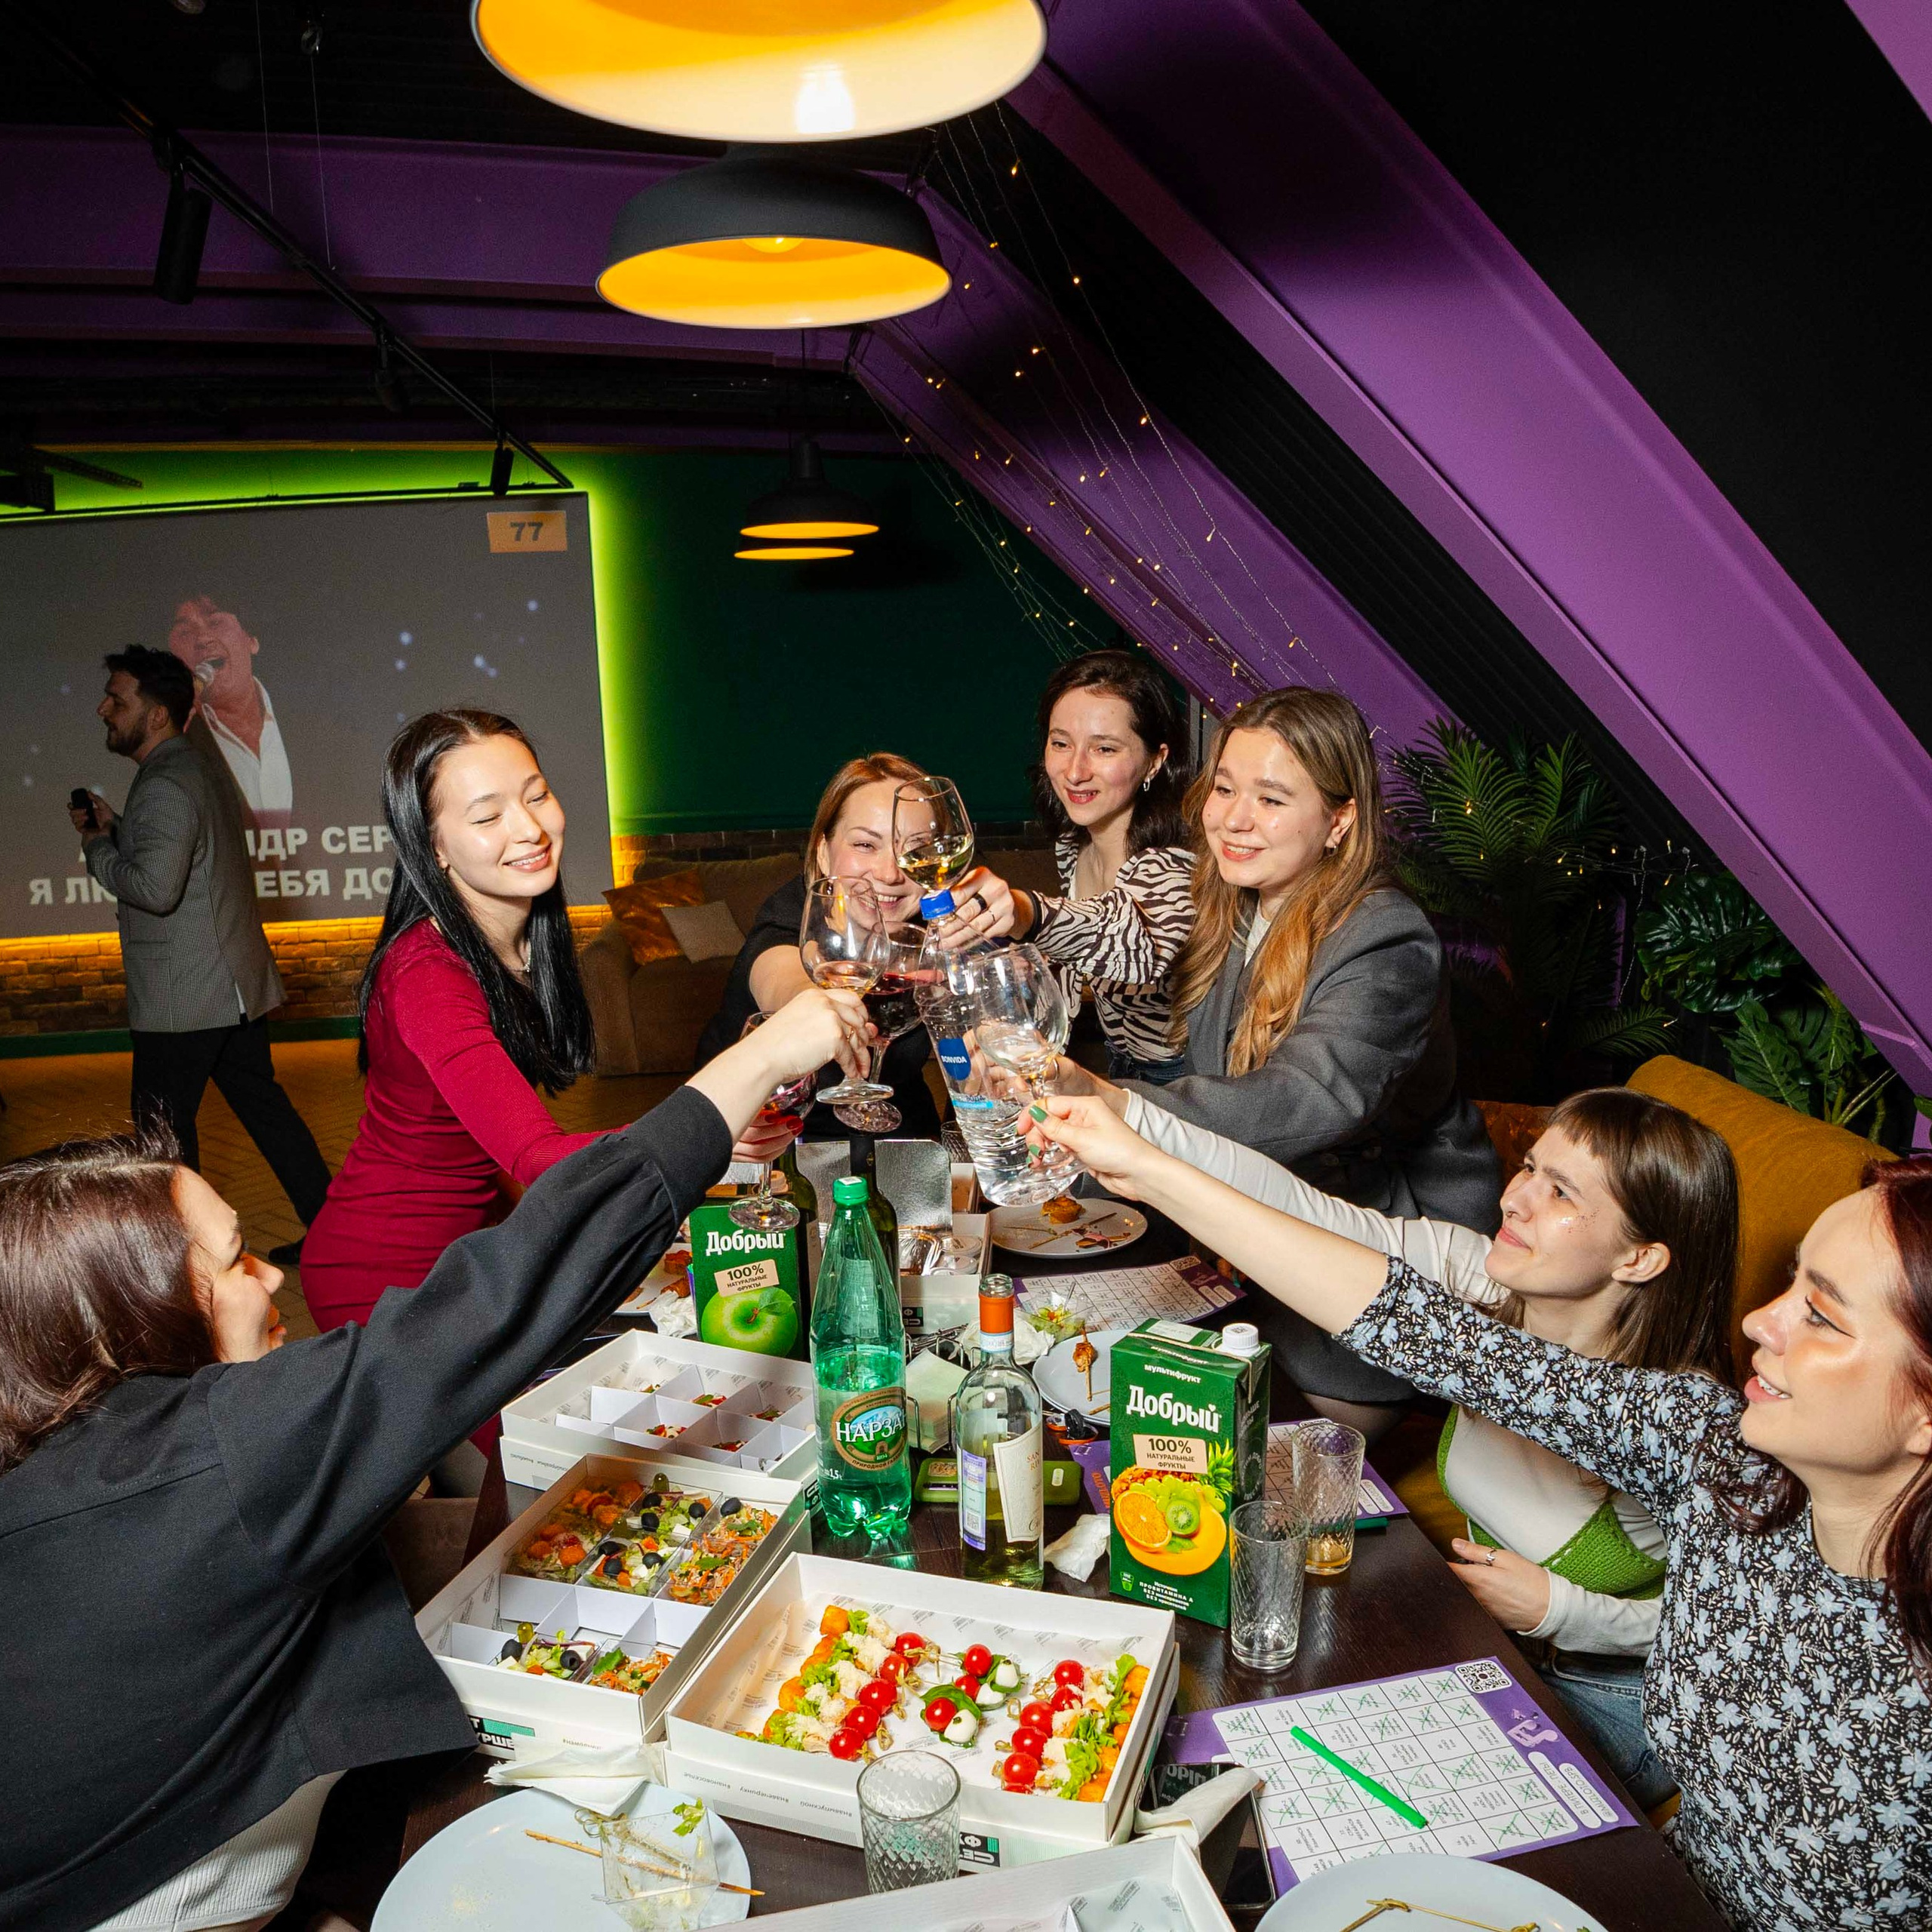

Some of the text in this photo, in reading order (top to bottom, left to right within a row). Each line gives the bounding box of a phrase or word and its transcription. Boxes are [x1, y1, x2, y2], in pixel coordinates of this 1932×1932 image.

[510, 521, 543, 542] 77
[29, 878, 53, 906] Я
[706, 1229, 786, 1257] Добрый
[727, 1275, 768, 1288] НАТУРАЛЬНЫЕ
[728, 1263, 764, 1281] 100%
[737, 1281, 761, 1292] ФРУКТЫ
[1151, 1346, 1209, 1364] мультифрукт
[1144, 1364, 1201, 1383] мультифрукт
[1126, 1384, 1220, 1434] Добрый
[1148, 1438, 1192, 1454] 100%
[1146, 1453, 1195, 1463] НАТУРАЛЬНЫЕ
[1157, 1461, 1186, 1470] ФРУКТЫ
[1139, 1581, 1187, 1601] ПРОВИТАМИНА
[1537, 1761, 1560, 1780] ПЕТЬ!
[683, 1771, 854, 1818] #навыпускной #навечеринку #нановоселье
[1555, 1783, 1584, 1808] ПИТЕРЕ
[1562, 1765, 1614, 1818] @MUZLOTO.SPB
